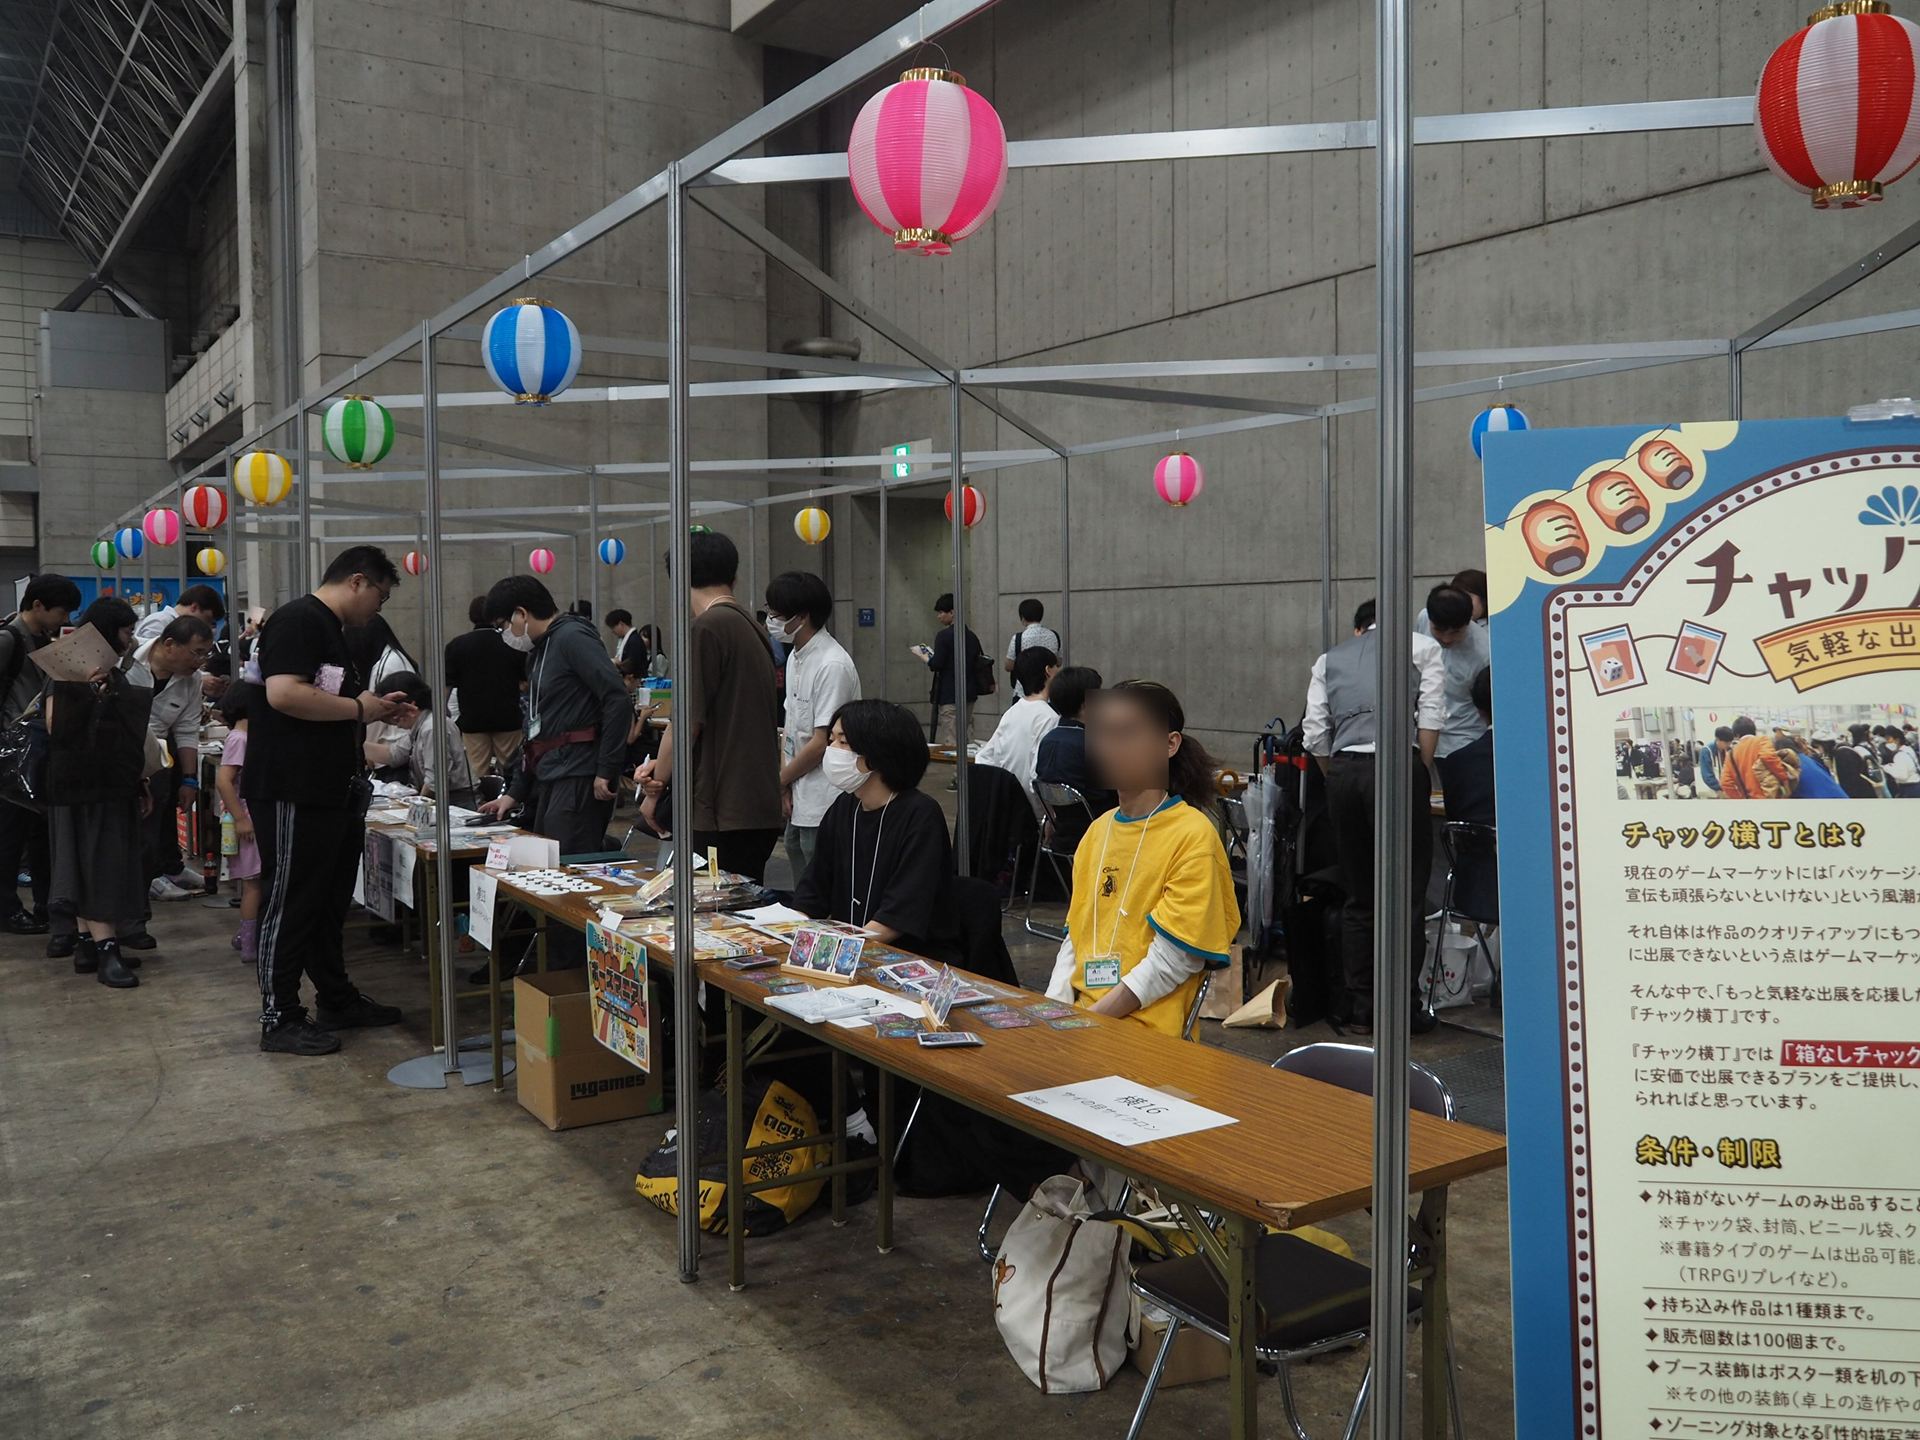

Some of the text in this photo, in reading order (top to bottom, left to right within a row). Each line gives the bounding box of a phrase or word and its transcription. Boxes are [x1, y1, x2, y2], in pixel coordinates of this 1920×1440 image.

[1786, 621, 1916, 669] 気軽な出
[1621, 820, 1867, 849] チャック横丁とは？
[1623, 864, 1920, 881] 現在のゲームマーケットには「パッケージ
[1624, 887, 1920, 904] 宣伝も頑張らないといけない」という風潮
[1630, 1005, 1780, 1025] 『チャック横丁』です。
[1631, 1042, 1774, 1062] 『チャック横丁』では
[1635, 1091, 1817, 1111] られればと思っています。
[1635, 1134, 1782, 1169] 条件・制限
[1661, 1295, 1875, 1321] 持ち込み作品は1種類まで。
[1662, 1327, 1846, 1352] 販売個数は100個まで。
